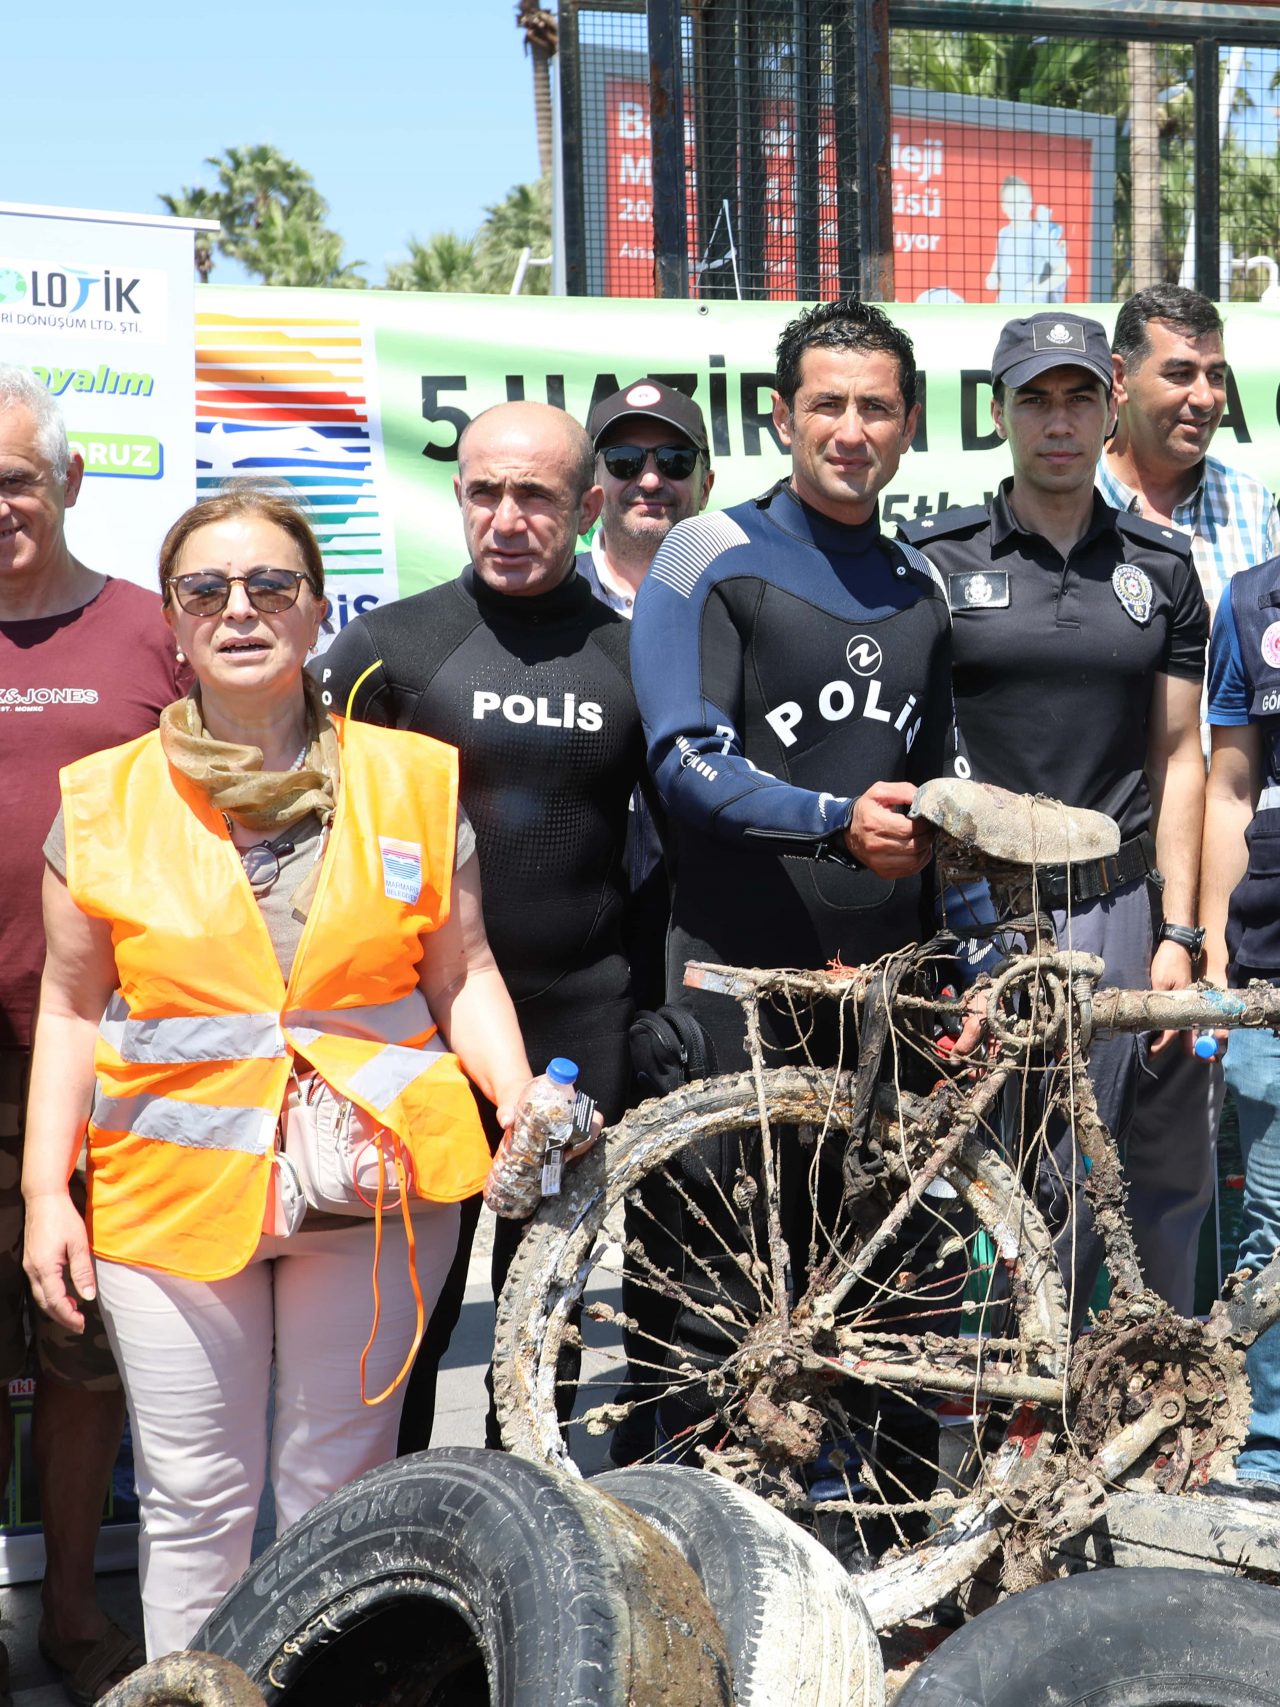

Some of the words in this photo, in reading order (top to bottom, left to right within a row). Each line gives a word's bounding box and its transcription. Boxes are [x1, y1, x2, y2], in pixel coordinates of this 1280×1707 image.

[17, 313, 87, 330] DÖNÜŞÜM
[90, 320, 117, 332] LTD.
[120, 321, 142, 334] ŞTİ.
[421, 375, 471, 462] 5
[473, 690, 603, 732] POLİS
